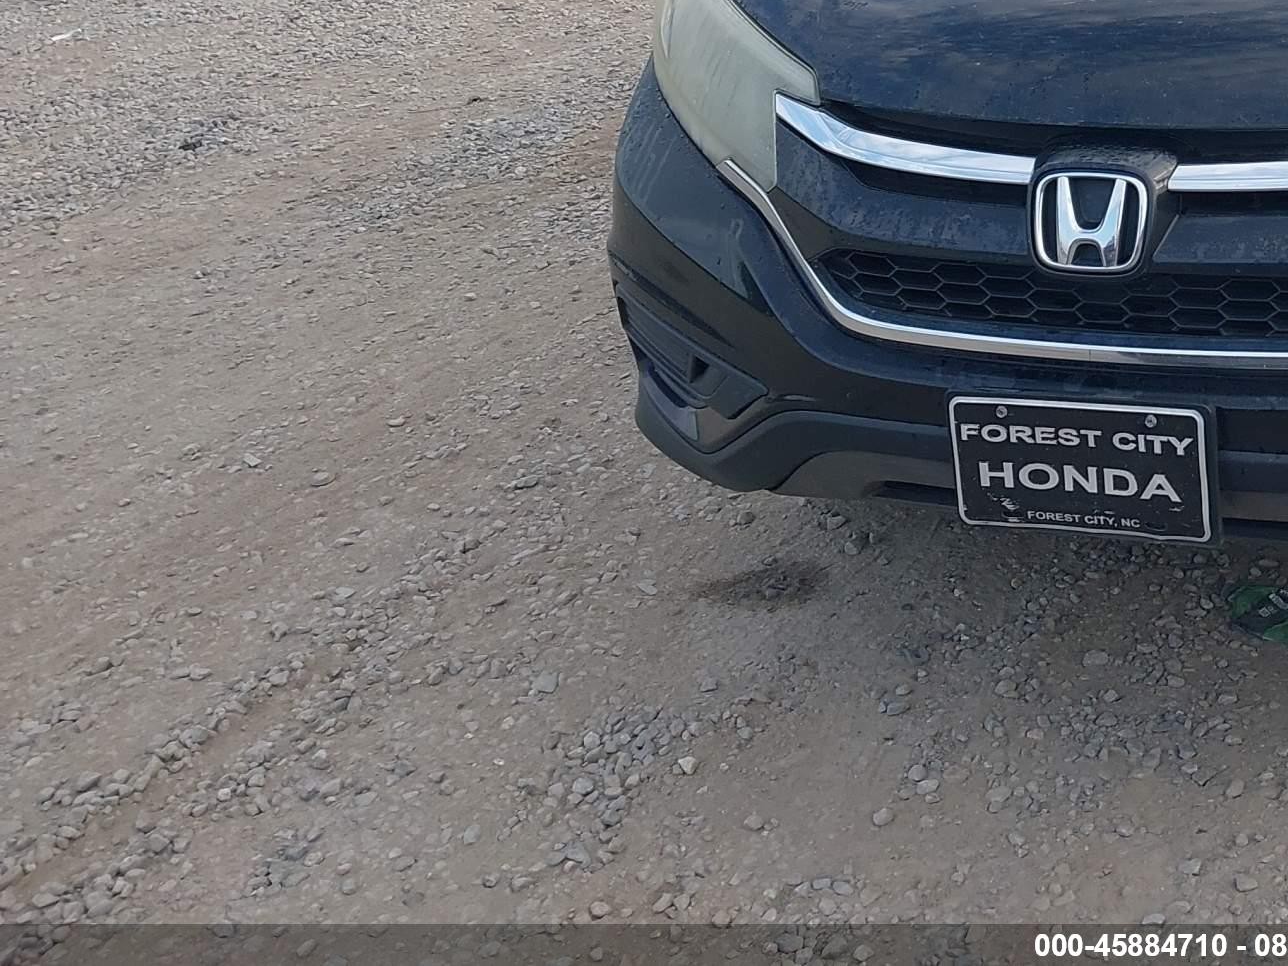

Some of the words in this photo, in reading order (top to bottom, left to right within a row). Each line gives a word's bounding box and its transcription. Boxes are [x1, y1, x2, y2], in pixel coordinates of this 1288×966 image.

[960, 423, 1102, 448] FOREST
[1112, 432, 1194, 456] CITY
[978, 461, 1183, 503] HONDA
[1027, 510, 1081, 523] FOREST
[1084, 515, 1118, 528] CITY,
[1121, 518, 1141, 528] NC
